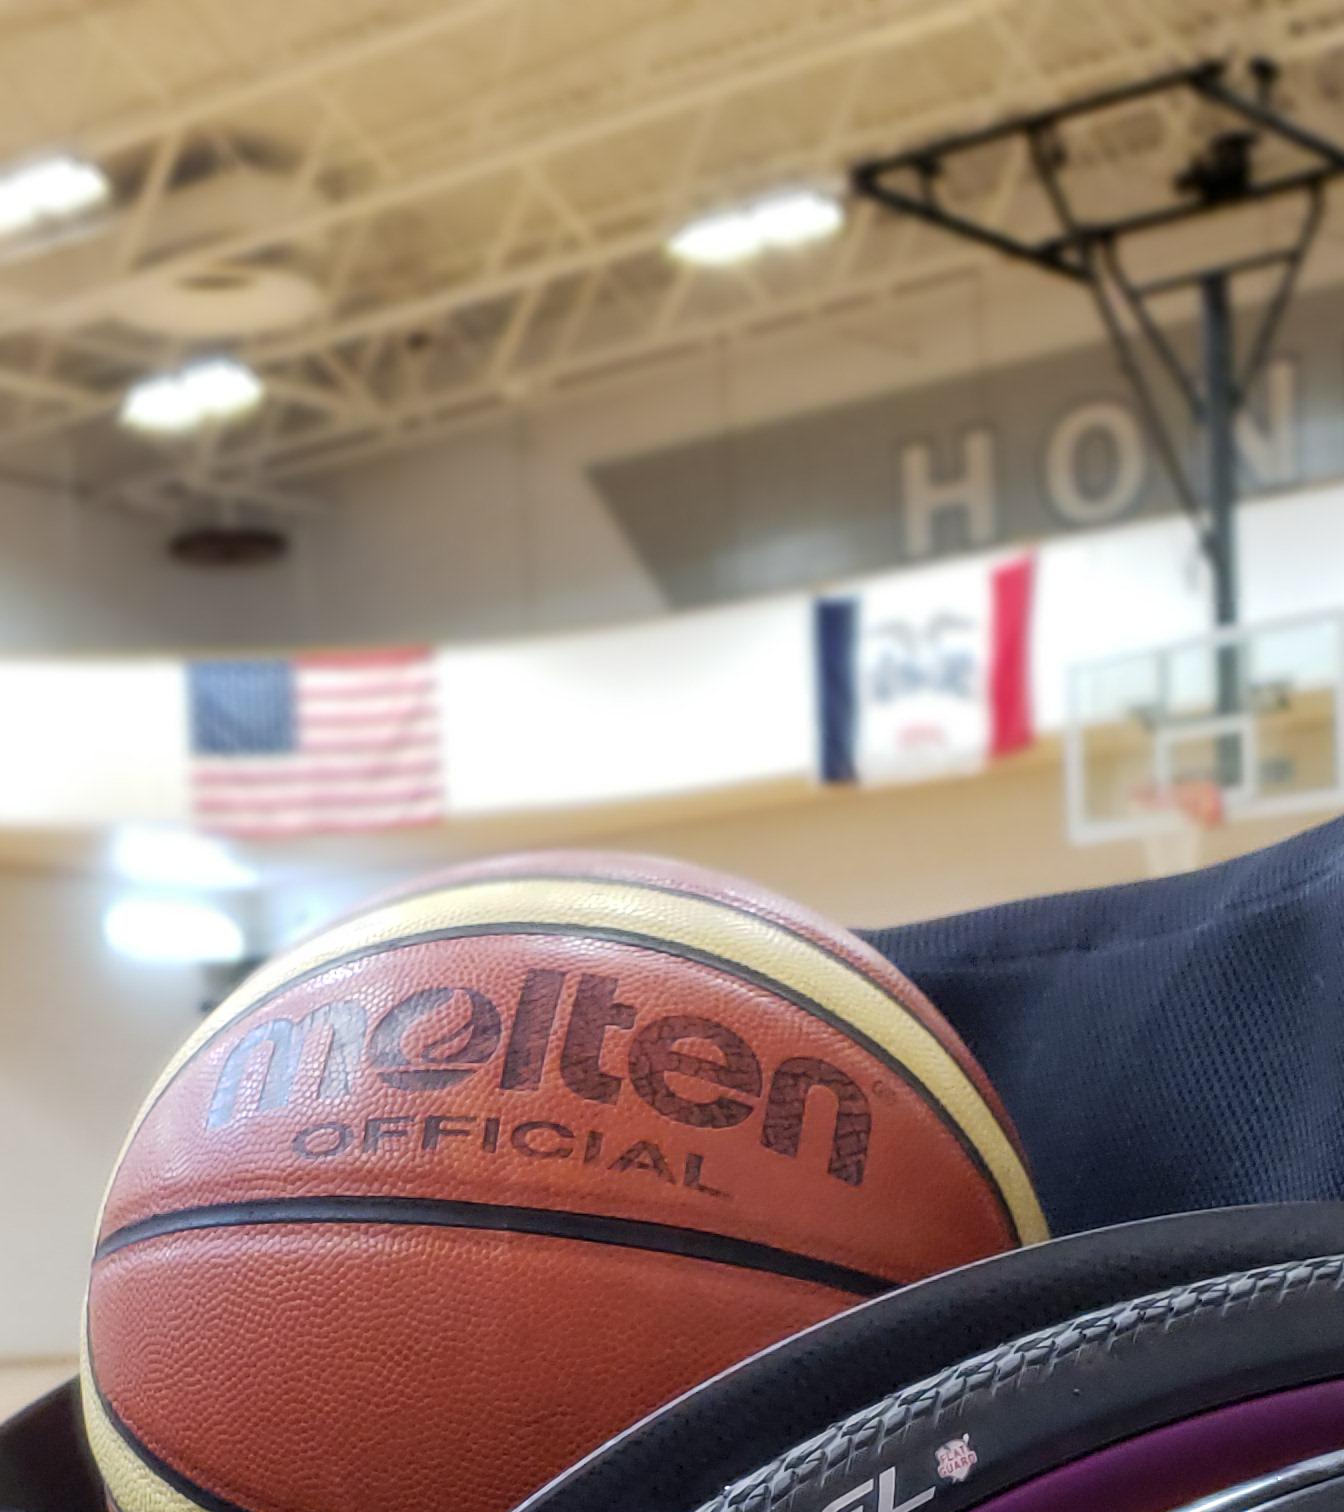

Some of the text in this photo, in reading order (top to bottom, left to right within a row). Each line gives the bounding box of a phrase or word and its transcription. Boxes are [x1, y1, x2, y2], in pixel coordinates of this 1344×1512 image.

[205, 968, 873, 1187] molten
[293, 1114, 731, 1198] OFFICIAL
[939, 1444, 965, 1464] FLAT
[939, 1453, 976, 1475] GUARD
